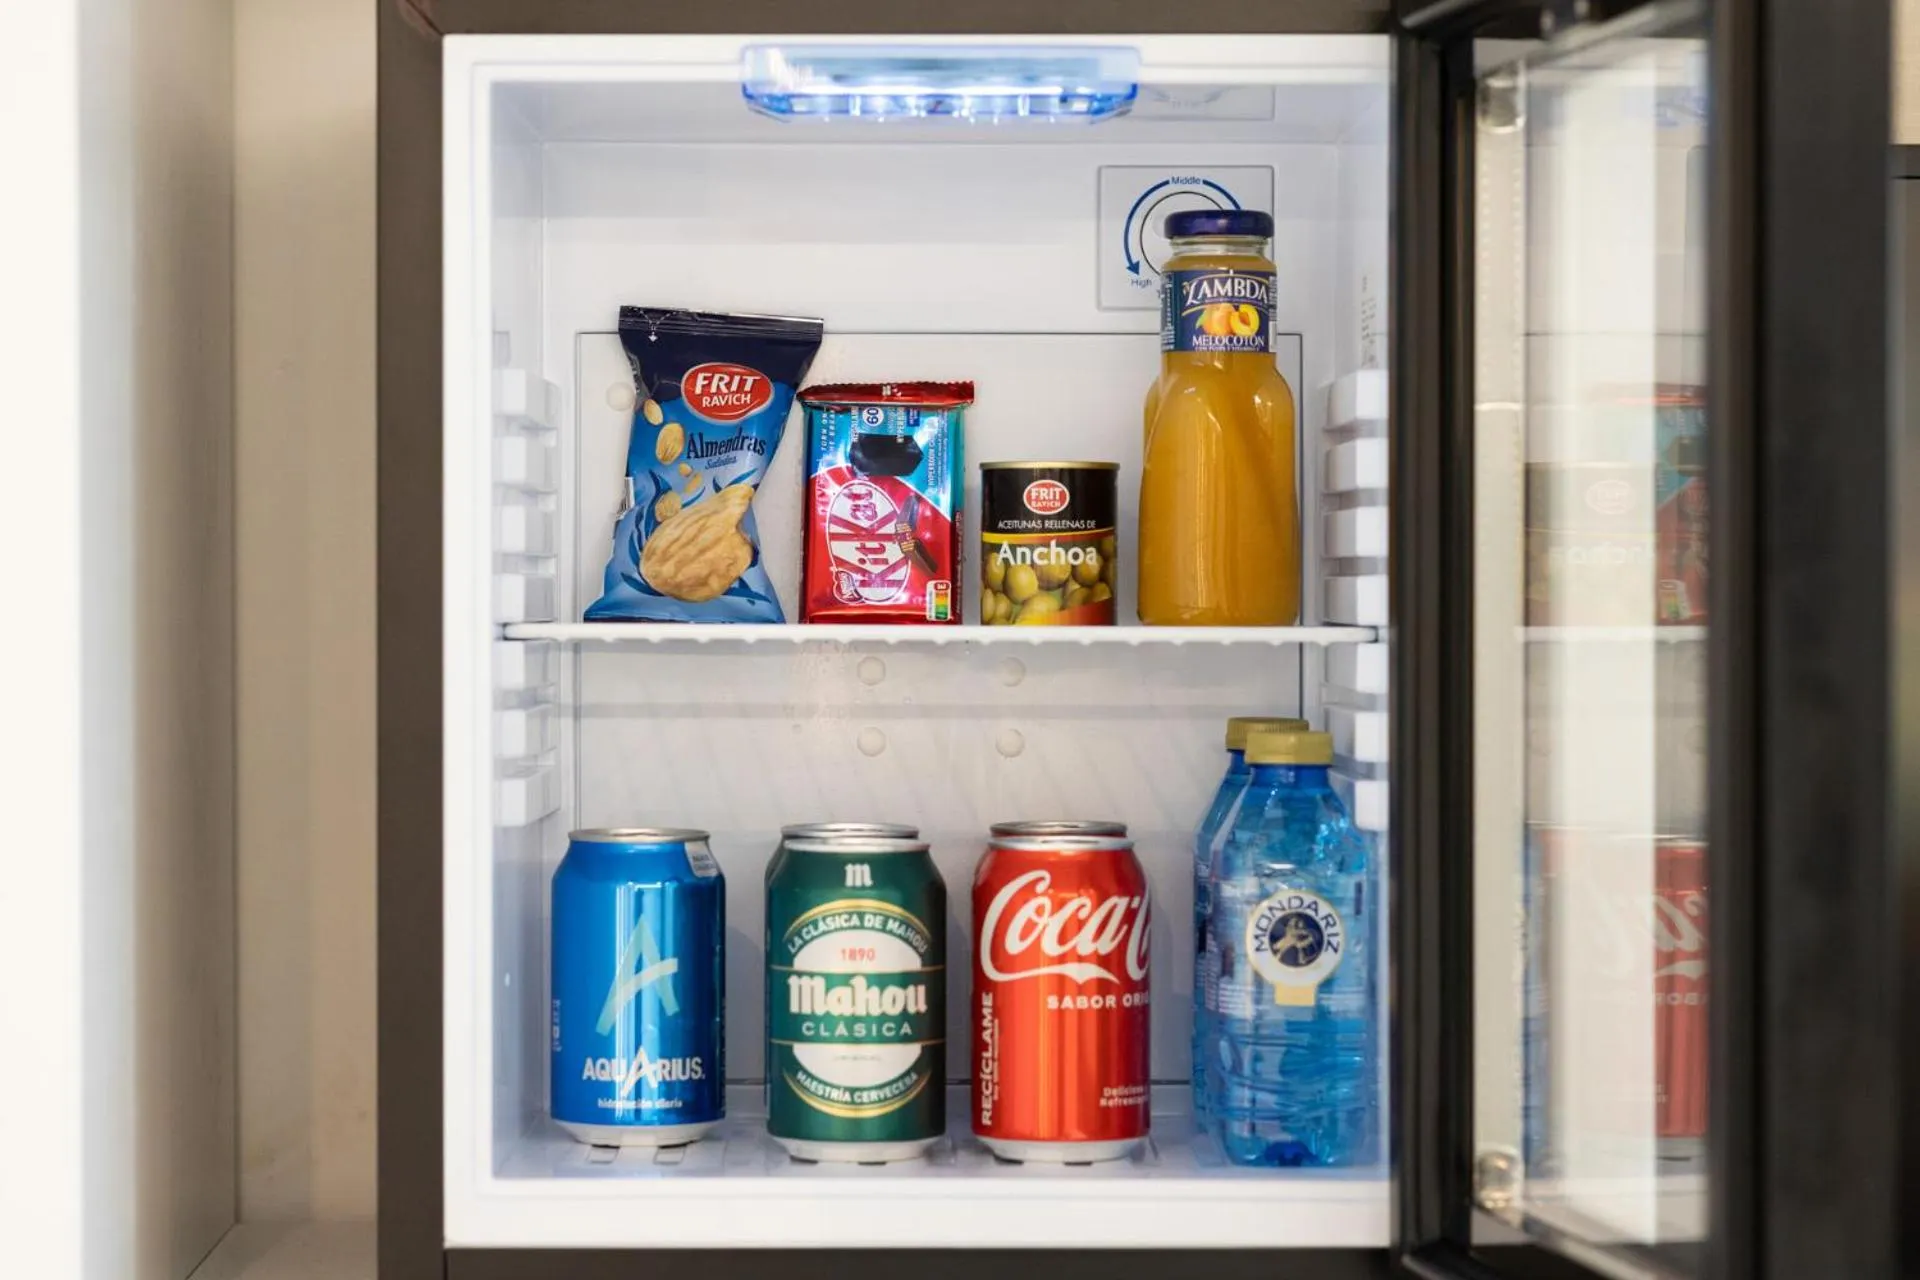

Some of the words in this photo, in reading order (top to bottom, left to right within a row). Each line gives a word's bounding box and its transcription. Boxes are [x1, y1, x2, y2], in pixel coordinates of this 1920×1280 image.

[1171, 176, 1201, 185] Middle
[1131, 279, 1152, 289] High
[1185, 278, 1268, 306] LAMBDA
[694, 372, 761, 395] FRIT
[702, 393, 751, 408] RAVICH
[866, 407, 879, 425] 60
[687, 426, 766, 459] Almendras
[1031, 487, 1062, 500] FRIT
[997, 520, 1042, 529] ACEITUNAS
[1044, 519, 1085, 529] RELLENAS
[1087, 520, 1096, 529] DE
[997, 539, 1097, 565] Anchoa
[787, 936, 804, 954] LA
[863, 913, 884, 928] DE
[885, 918, 929, 953] MAHOU
[1253, 895, 1341, 954] MONDARIZ
[841, 948, 876, 961] 1890
[1047, 994, 1117, 1010] SABOR
[980, 992, 993, 1126] RECÍCLAME
